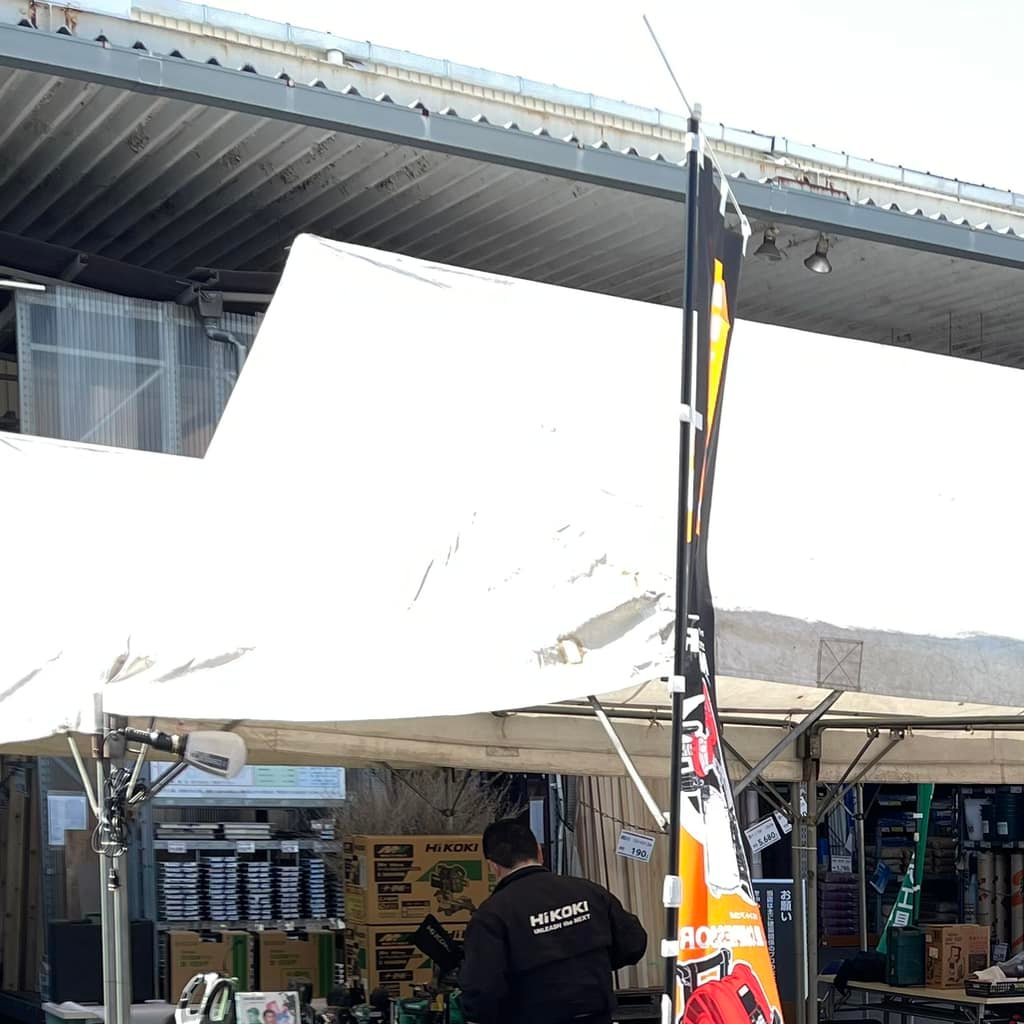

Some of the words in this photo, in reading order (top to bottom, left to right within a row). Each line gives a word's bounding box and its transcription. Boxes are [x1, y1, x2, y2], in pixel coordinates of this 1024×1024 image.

[425, 843, 479, 853] HiKOKI
[631, 847, 647, 858] 190
[529, 900, 589, 927] HiKOKI
[779, 889, 792, 922] お願い
